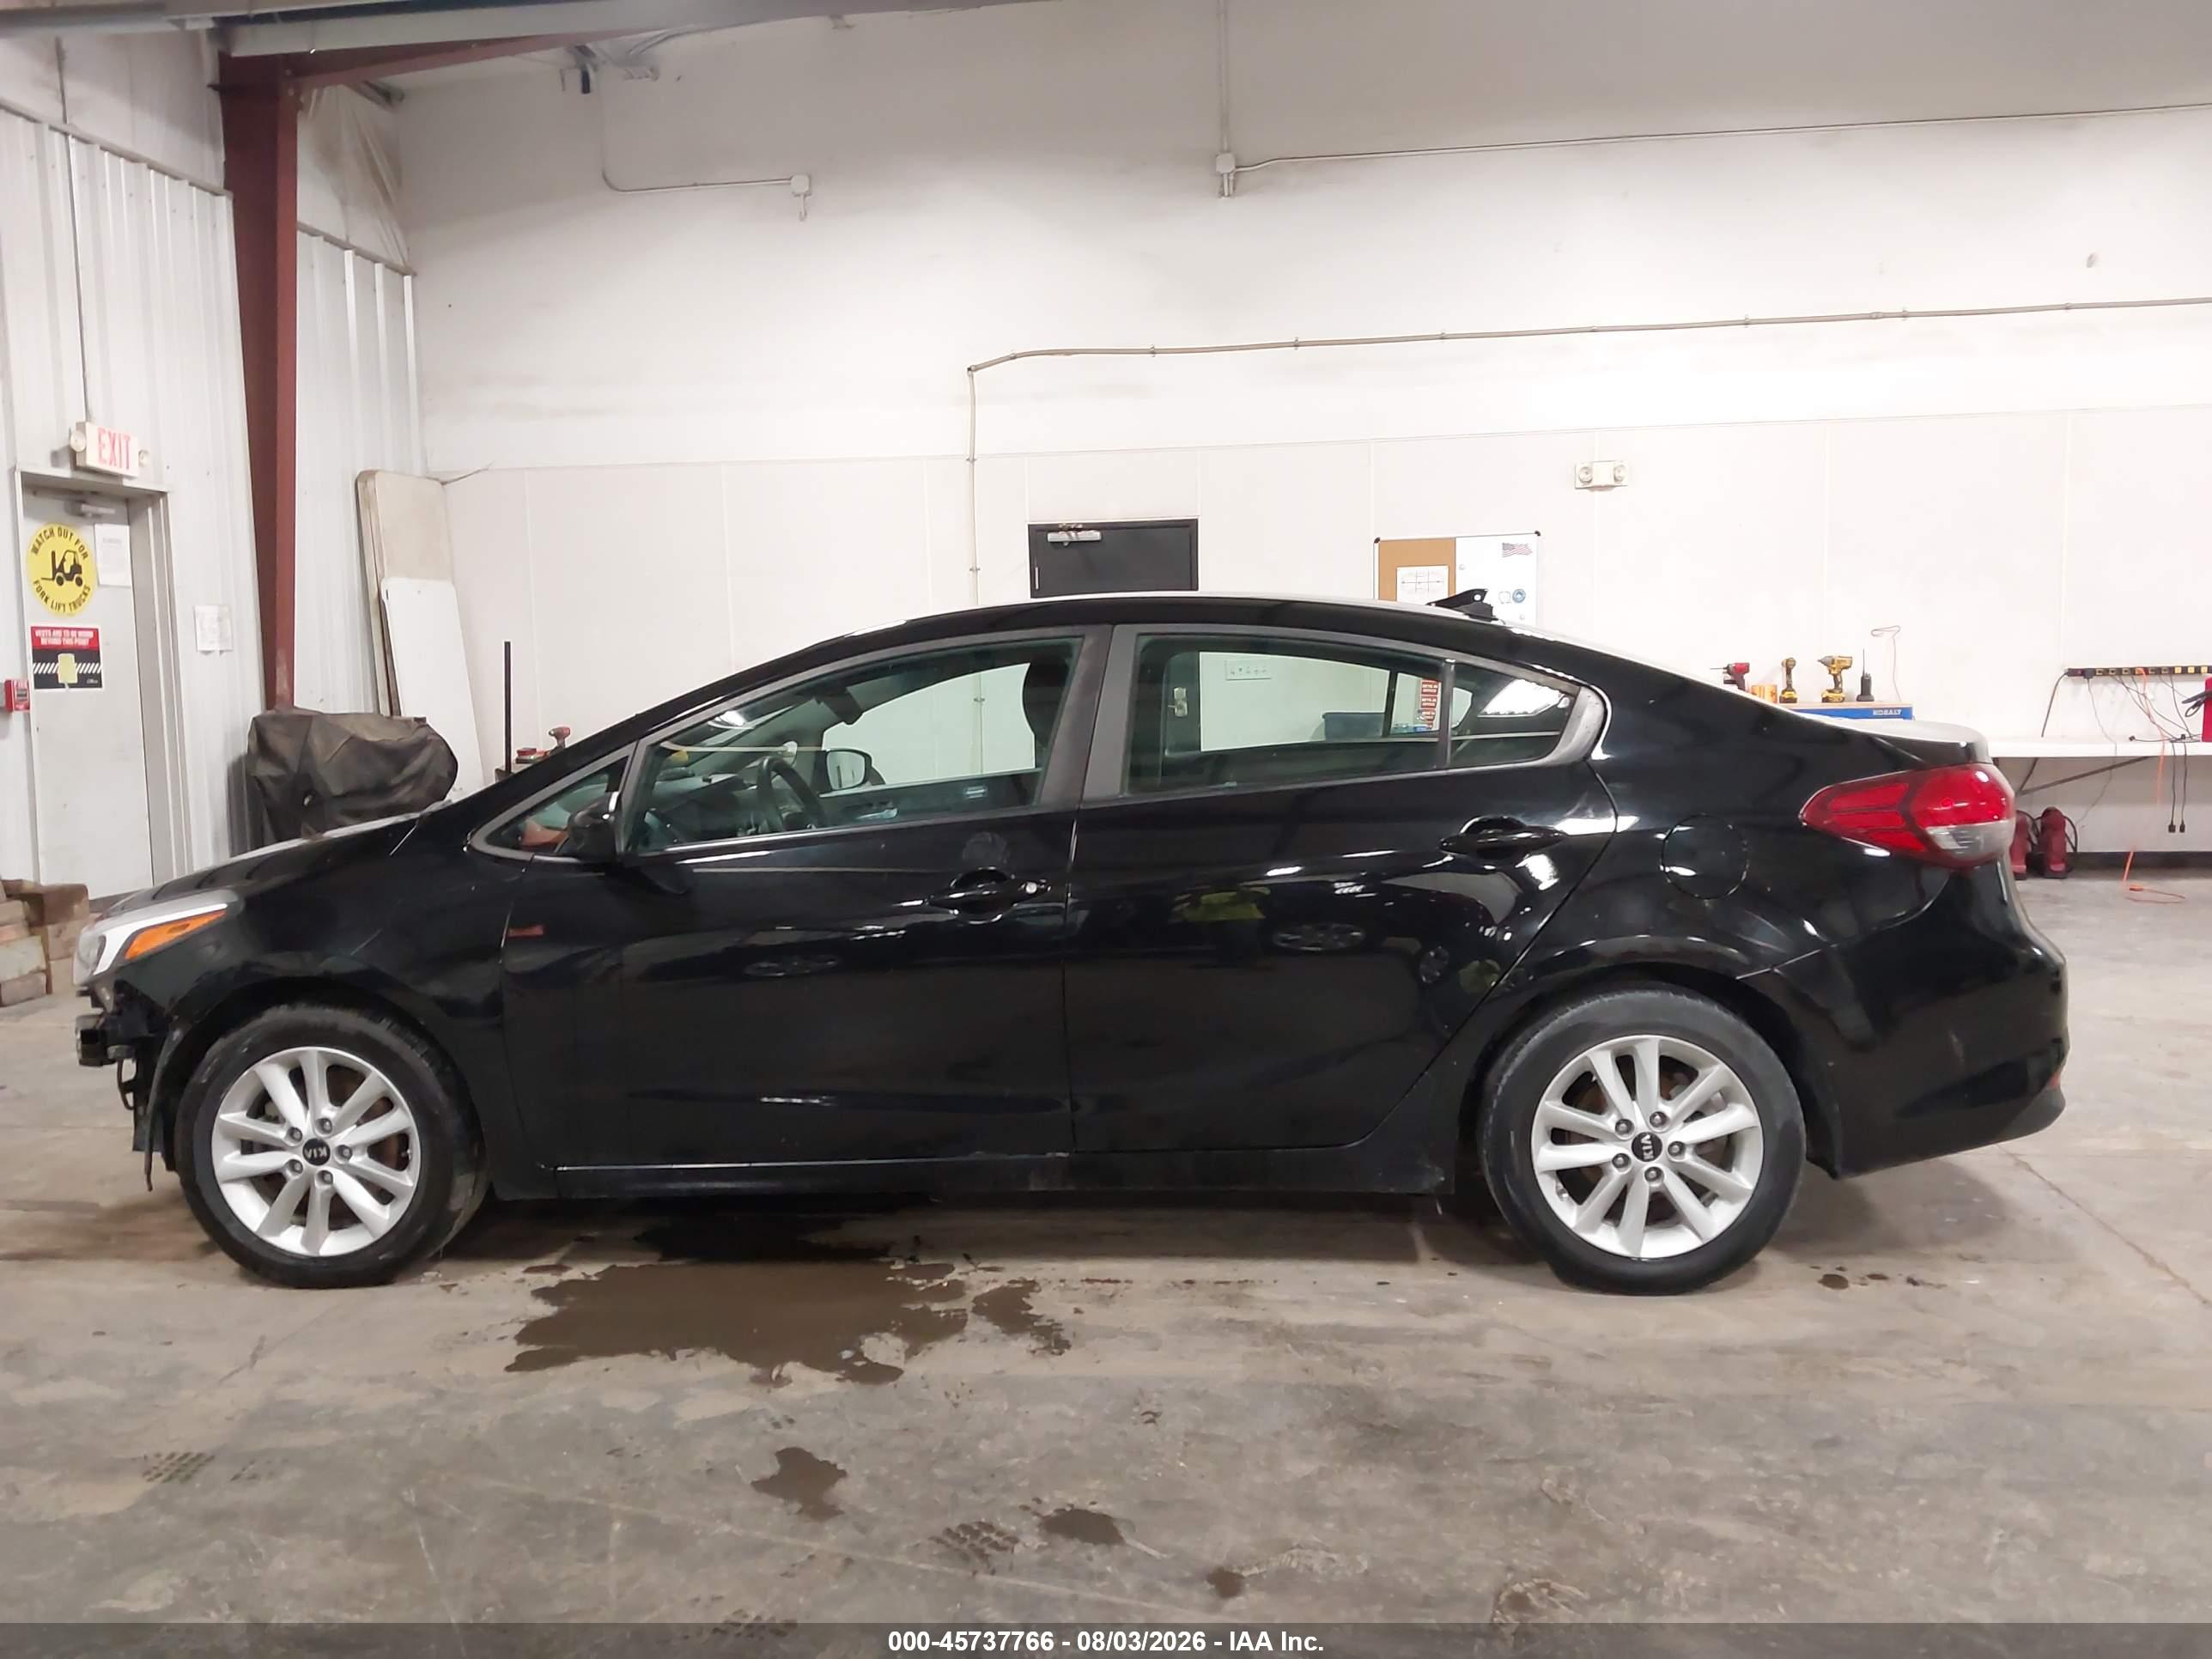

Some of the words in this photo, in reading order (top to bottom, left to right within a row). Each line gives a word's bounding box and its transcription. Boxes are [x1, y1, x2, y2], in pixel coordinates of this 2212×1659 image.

[97, 427, 131, 470] EXIT
[31, 527, 55, 556] WATCH
[57, 526, 74, 542] OUT
[74, 538, 89, 560] FOR
[33, 580, 50, 605] FORK
[51, 600, 67, 612] LIFT
[69, 585, 91, 612] TRUCKS
[304, 1146, 327, 1159] KIA
[1641, 1134, 1654, 1159] KIA
